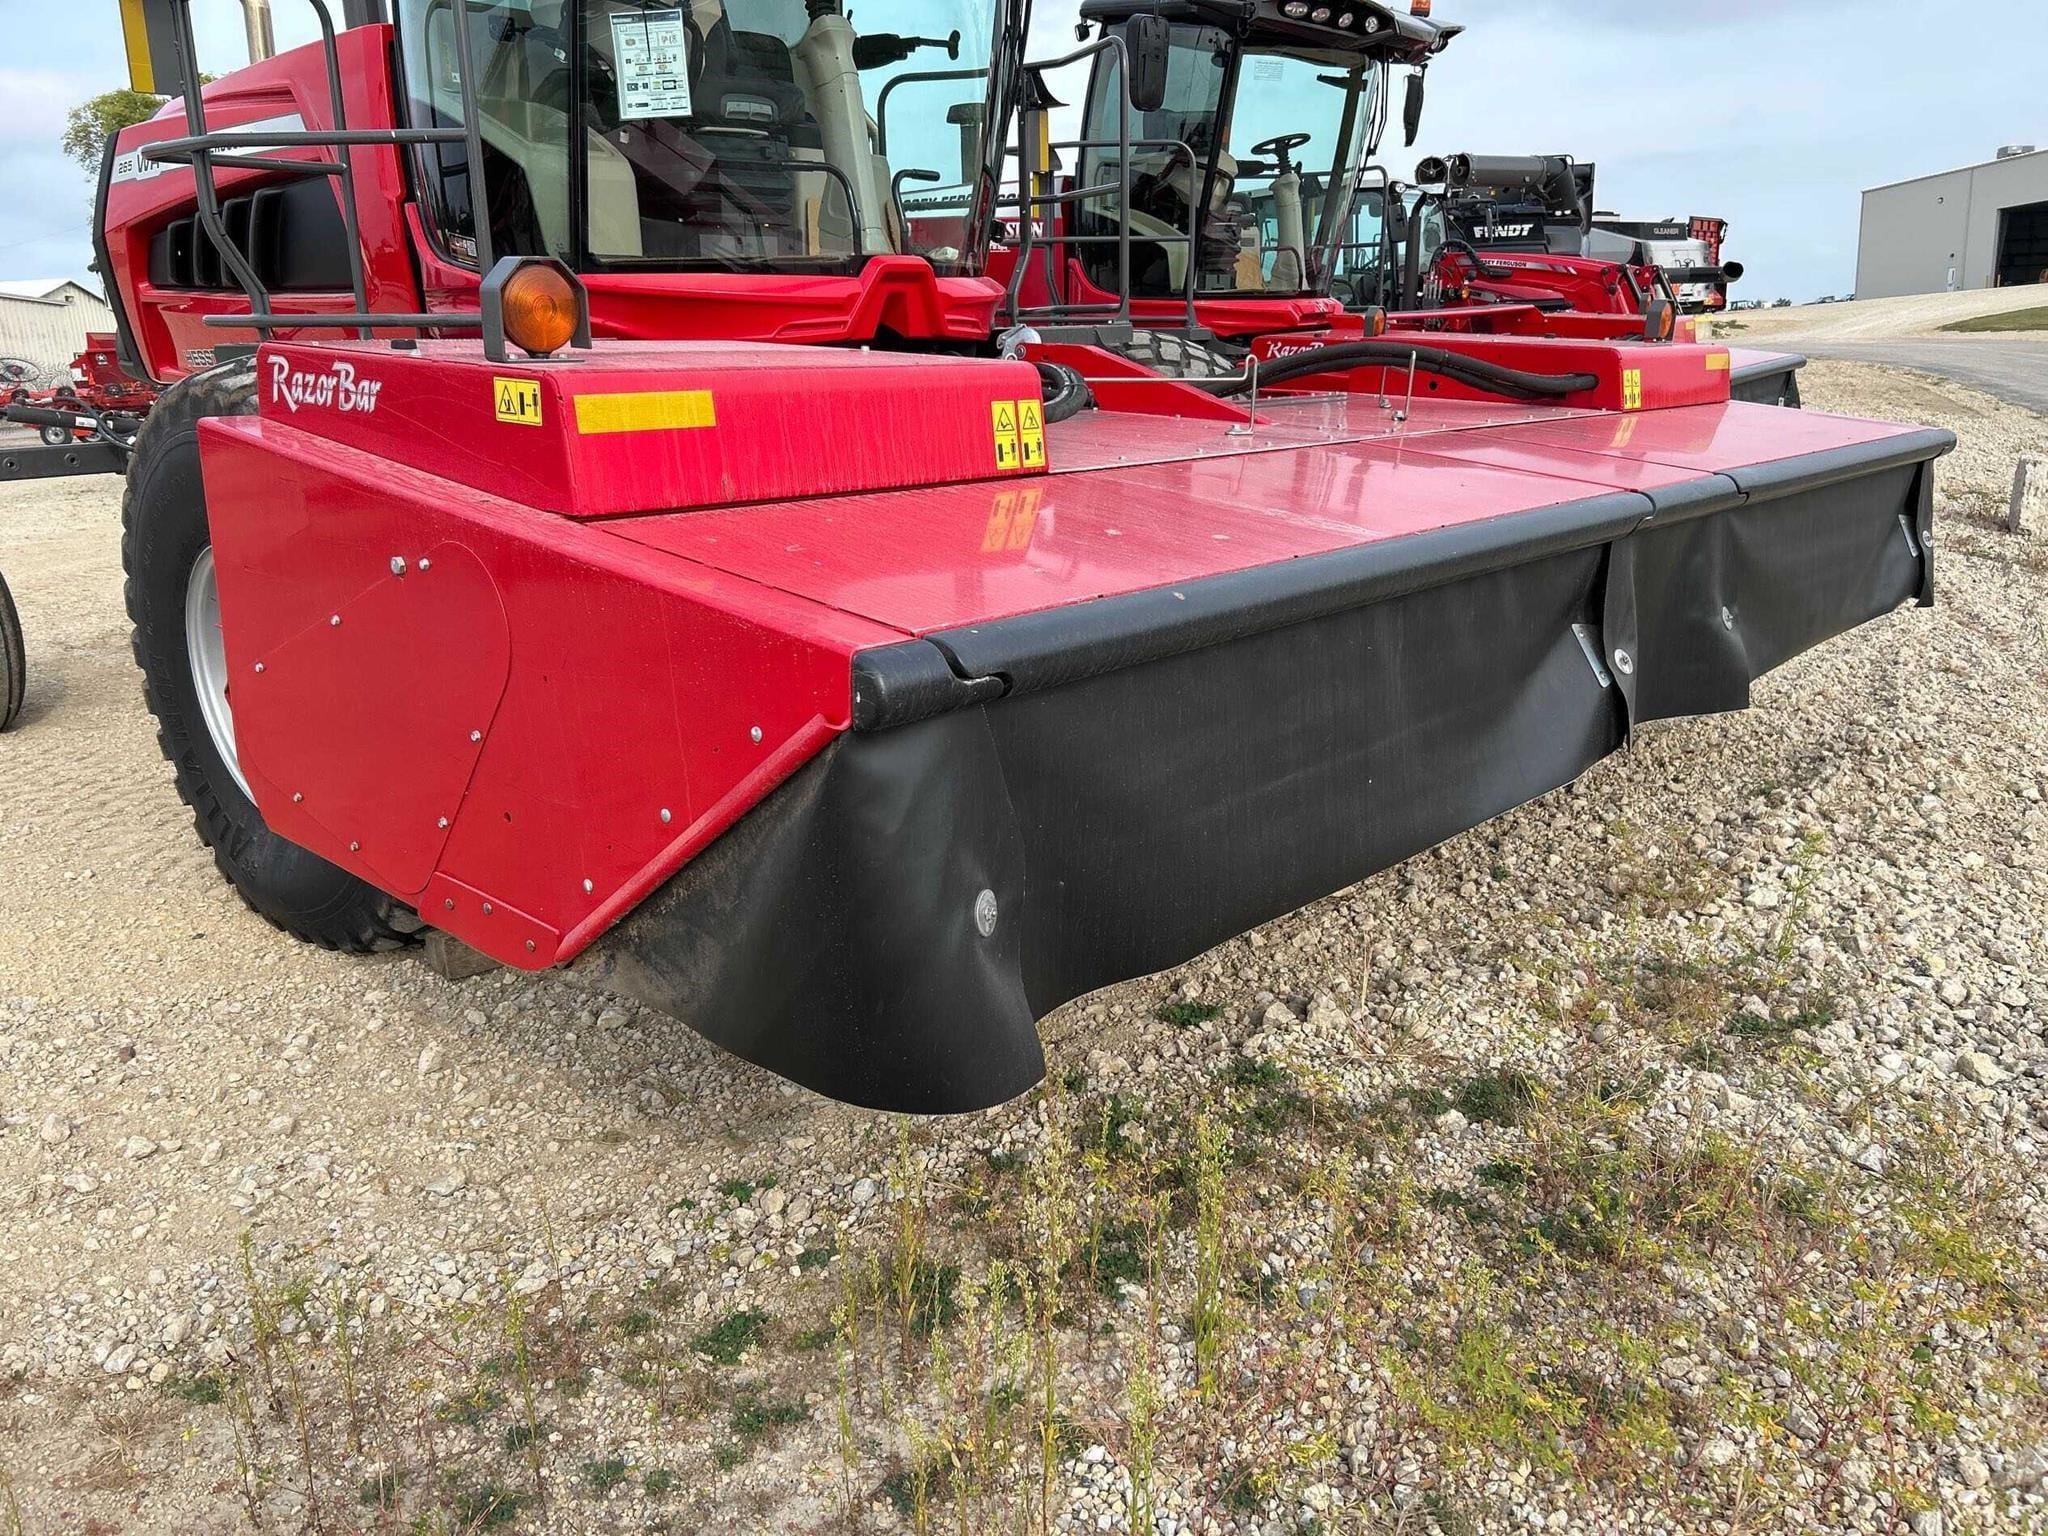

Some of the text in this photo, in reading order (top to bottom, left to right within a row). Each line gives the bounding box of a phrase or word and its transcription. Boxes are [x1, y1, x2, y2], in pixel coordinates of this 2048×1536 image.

[118, 160, 133, 174] 265
[1653, 227, 1679, 235] GLEANER
[1496, 260, 1527, 268] FERGUSON
[267, 354, 382, 413] RazorBar
